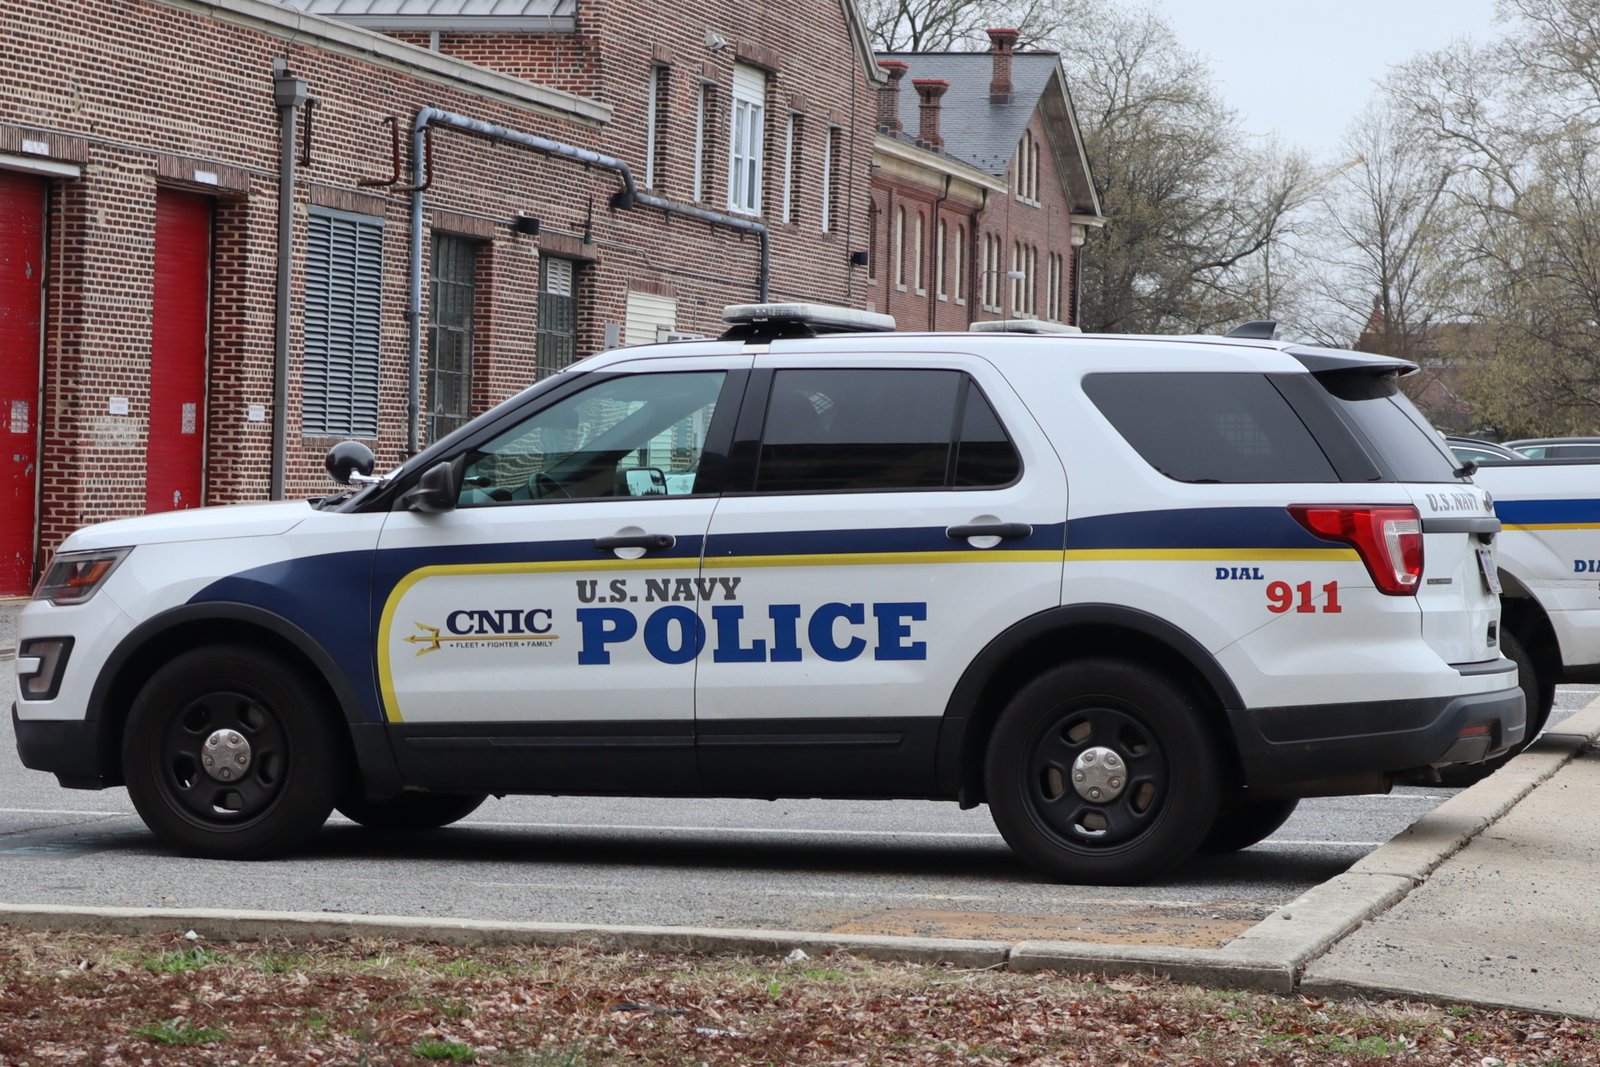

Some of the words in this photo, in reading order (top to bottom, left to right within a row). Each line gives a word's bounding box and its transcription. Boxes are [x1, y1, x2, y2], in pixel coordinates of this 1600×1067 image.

[1215, 567, 1264, 580] DIAL
[645, 577, 741, 602] NAVY
[1265, 580, 1342, 613] 911
[446, 609, 553, 635] CNIC
[576, 602, 927, 665] POLICE
